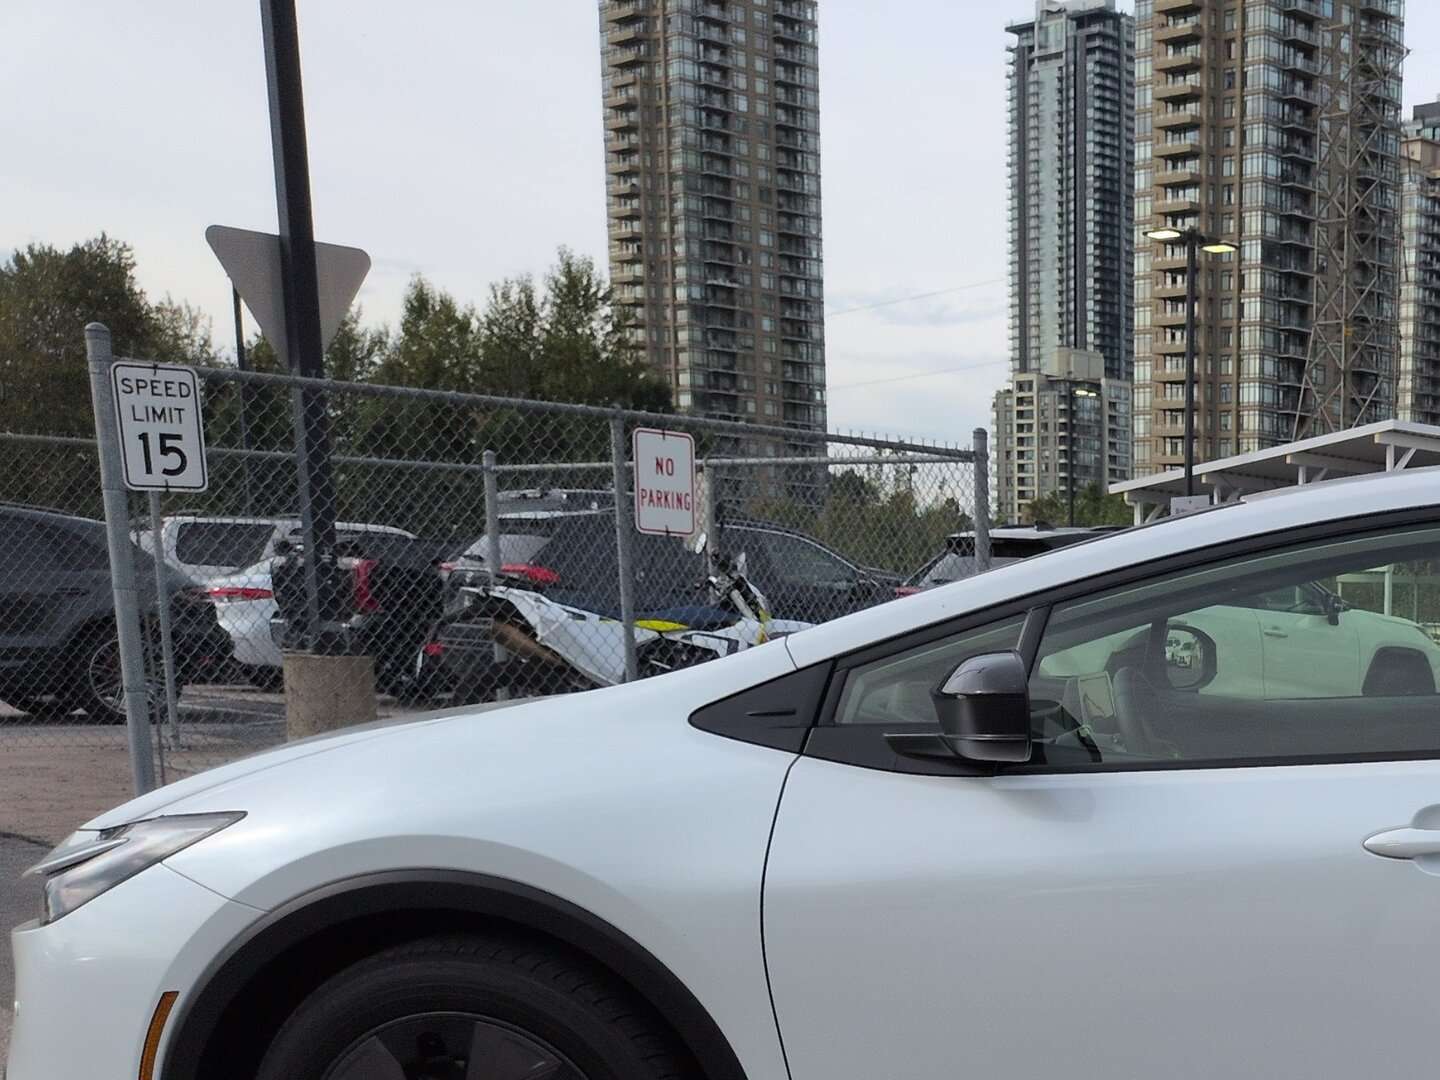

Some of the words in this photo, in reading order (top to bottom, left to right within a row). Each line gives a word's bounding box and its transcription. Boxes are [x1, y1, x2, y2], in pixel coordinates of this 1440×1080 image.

[121, 377, 191, 399] SPEED
[131, 404, 185, 425] LIMIT
[137, 431, 188, 477] 15
[655, 456, 674, 477] NO
[640, 487, 691, 512] PARKING
